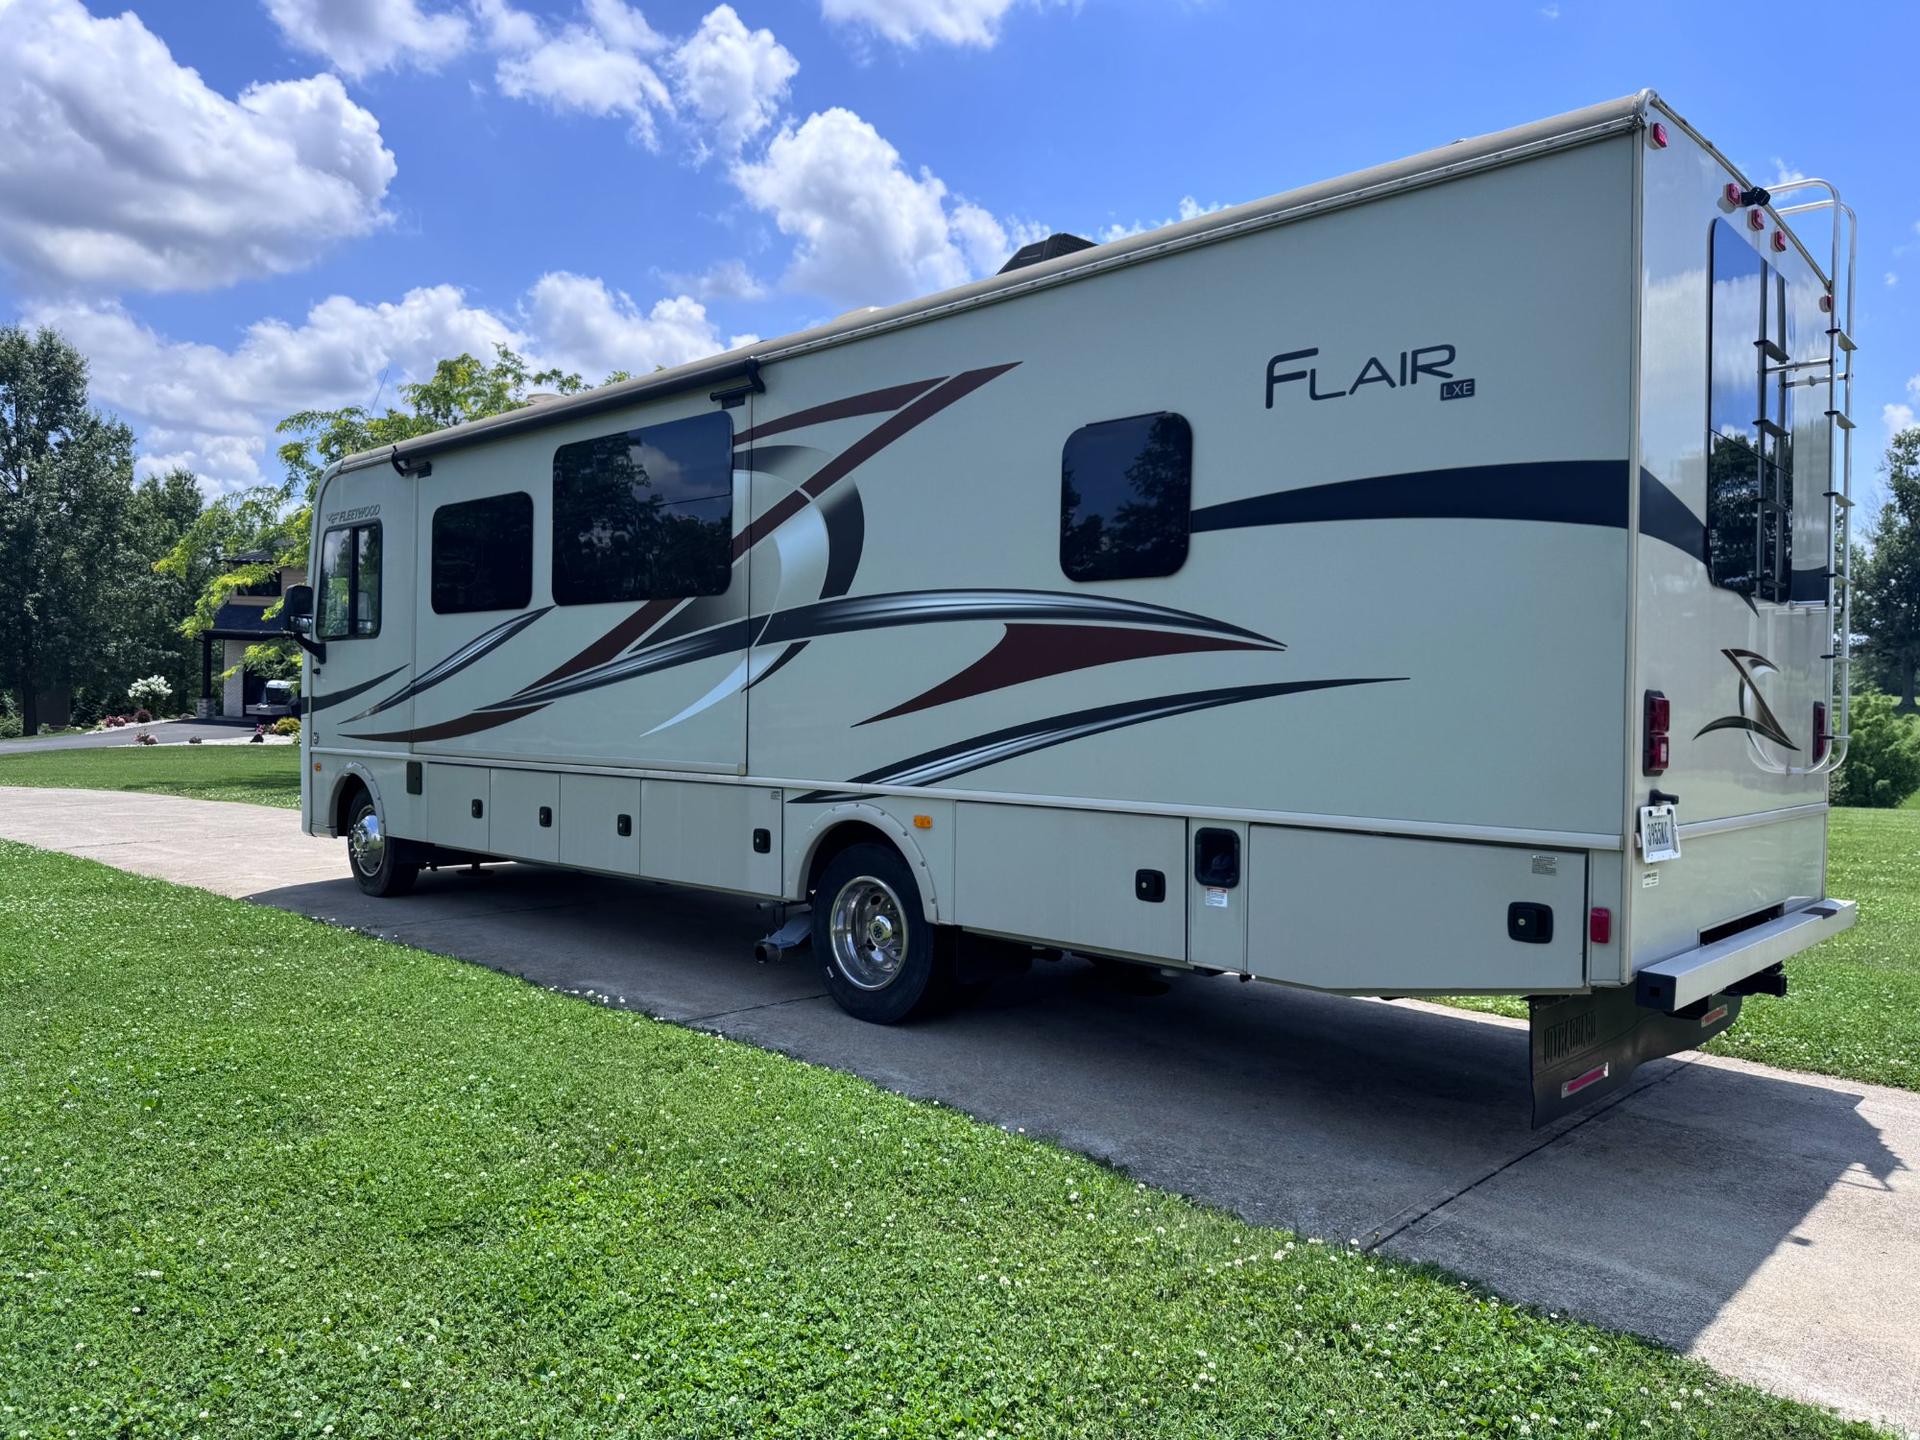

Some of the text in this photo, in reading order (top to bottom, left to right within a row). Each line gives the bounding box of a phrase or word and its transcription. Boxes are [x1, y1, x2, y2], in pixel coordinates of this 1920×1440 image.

[1265, 344, 1456, 409] FLAIR
[1442, 381, 1473, 399] LXE
[339, 504, 381, 522] FLEETWOOD
